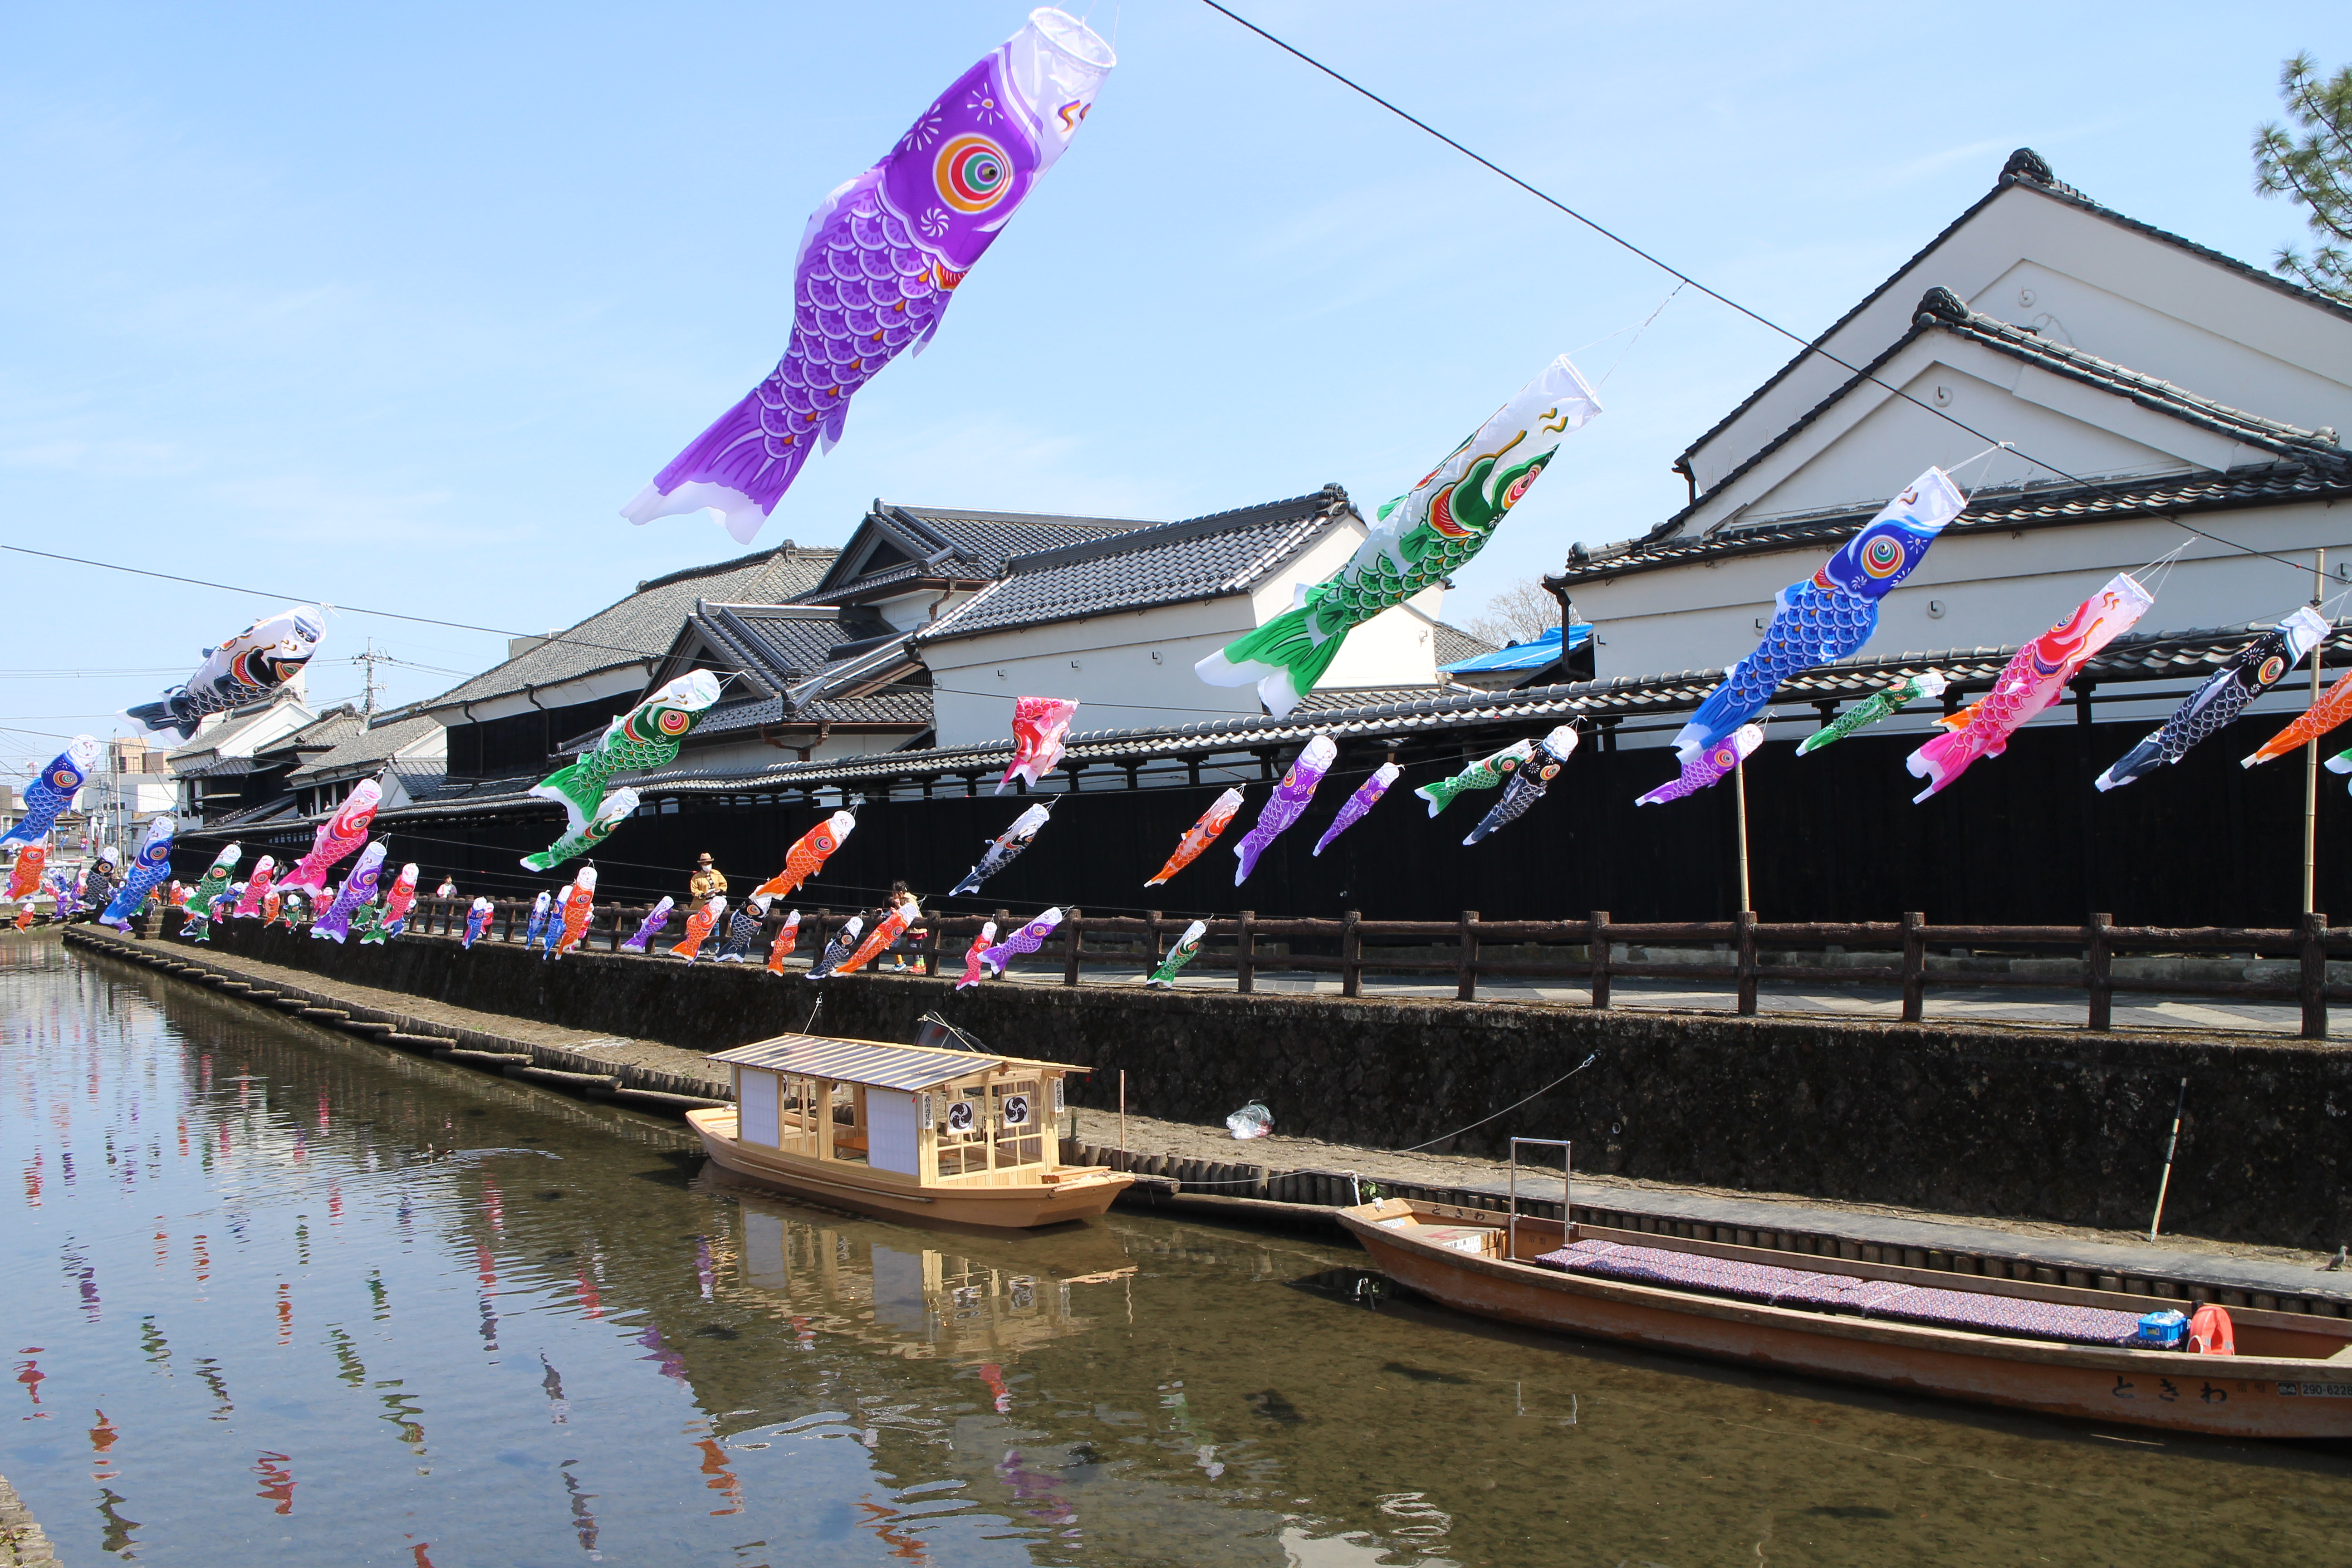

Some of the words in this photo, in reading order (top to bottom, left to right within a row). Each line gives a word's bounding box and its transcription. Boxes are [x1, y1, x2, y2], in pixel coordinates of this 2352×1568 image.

[1432, 1204, 1485, 1220] ときわ
[2112, 1375, 2227, 1404] ときわ
